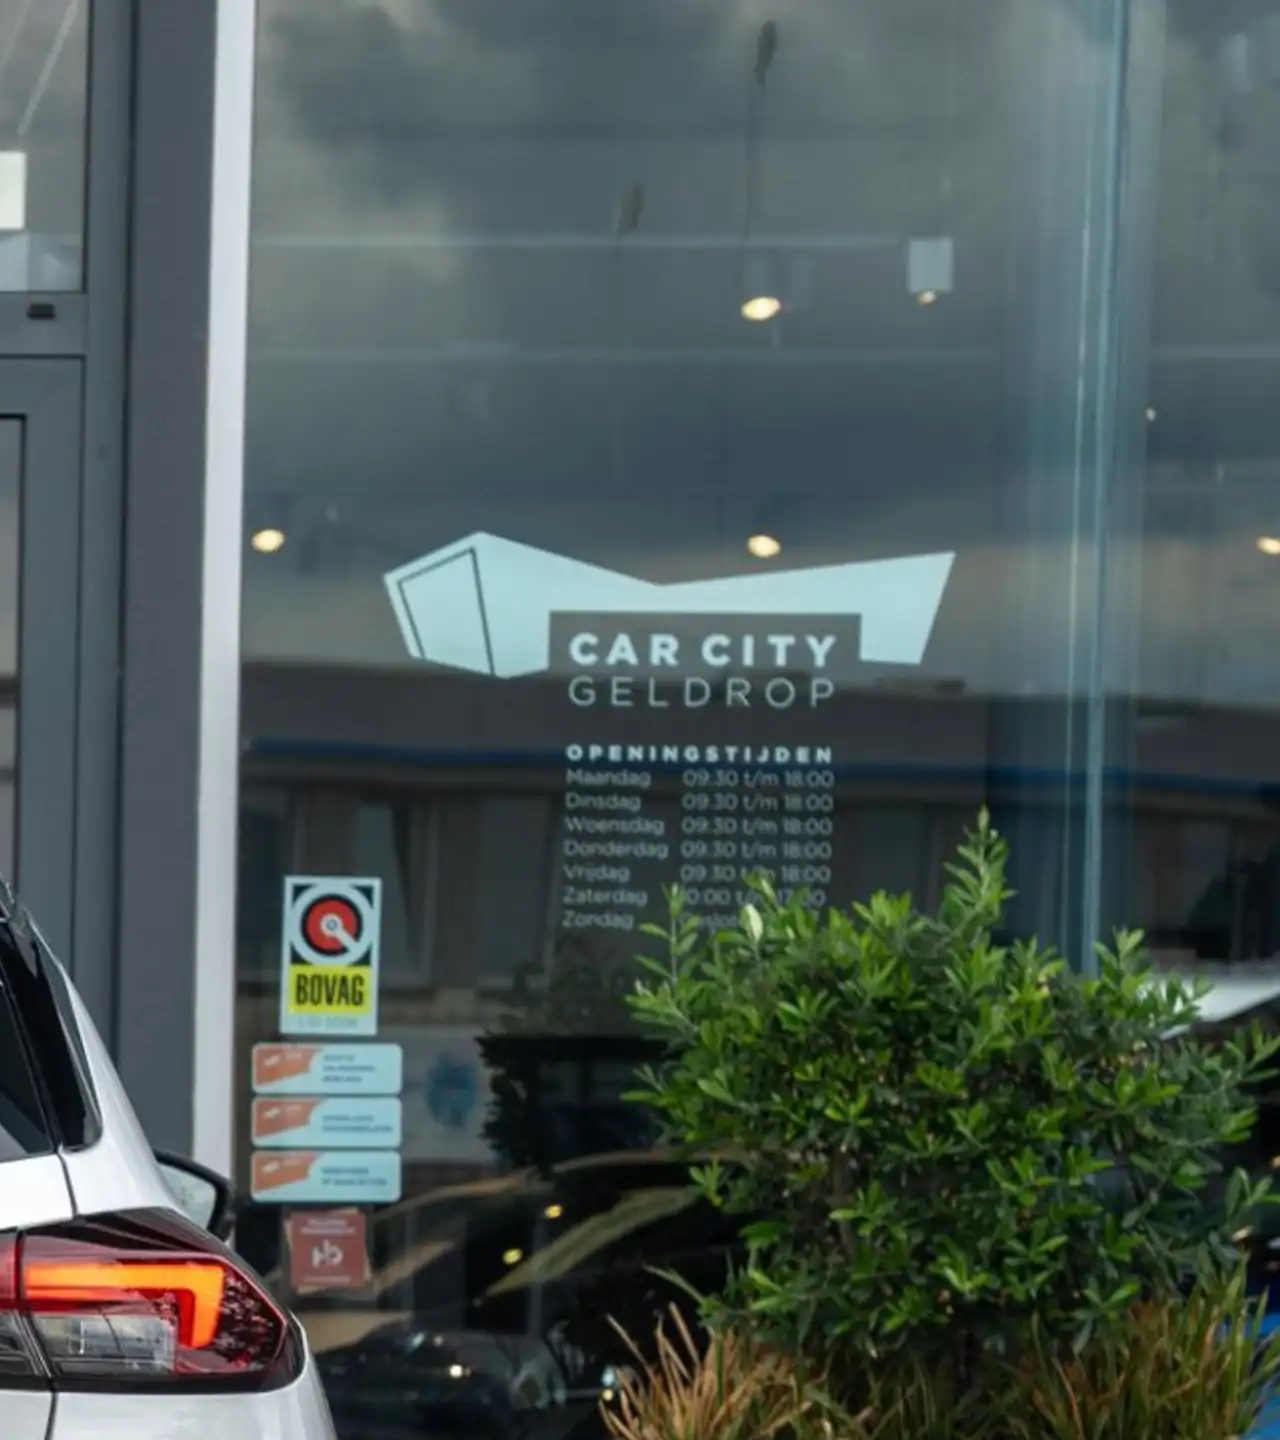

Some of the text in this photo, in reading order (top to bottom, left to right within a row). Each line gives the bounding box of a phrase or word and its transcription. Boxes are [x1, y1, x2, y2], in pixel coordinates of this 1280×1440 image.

[569, 633, 837, 669] CAR CITY
[567, 675, 836, 709] GELDROP
[565, 744, 833, 764] OPENINGSTIJDEN
[565, 769, 652, 789] Maandag
[564, 792, 642, 812] Dinsdag
[563, 816, 666, 836] Woensdag
[562, 840, 670, 860] Donderdag
[562, 863, 631, 884] Vrijdag
[562, 886, 649, 907] Zaterdag
[562, 909, 635, 931] Zondag
[295, 972, 365, 1007] BOVAG
